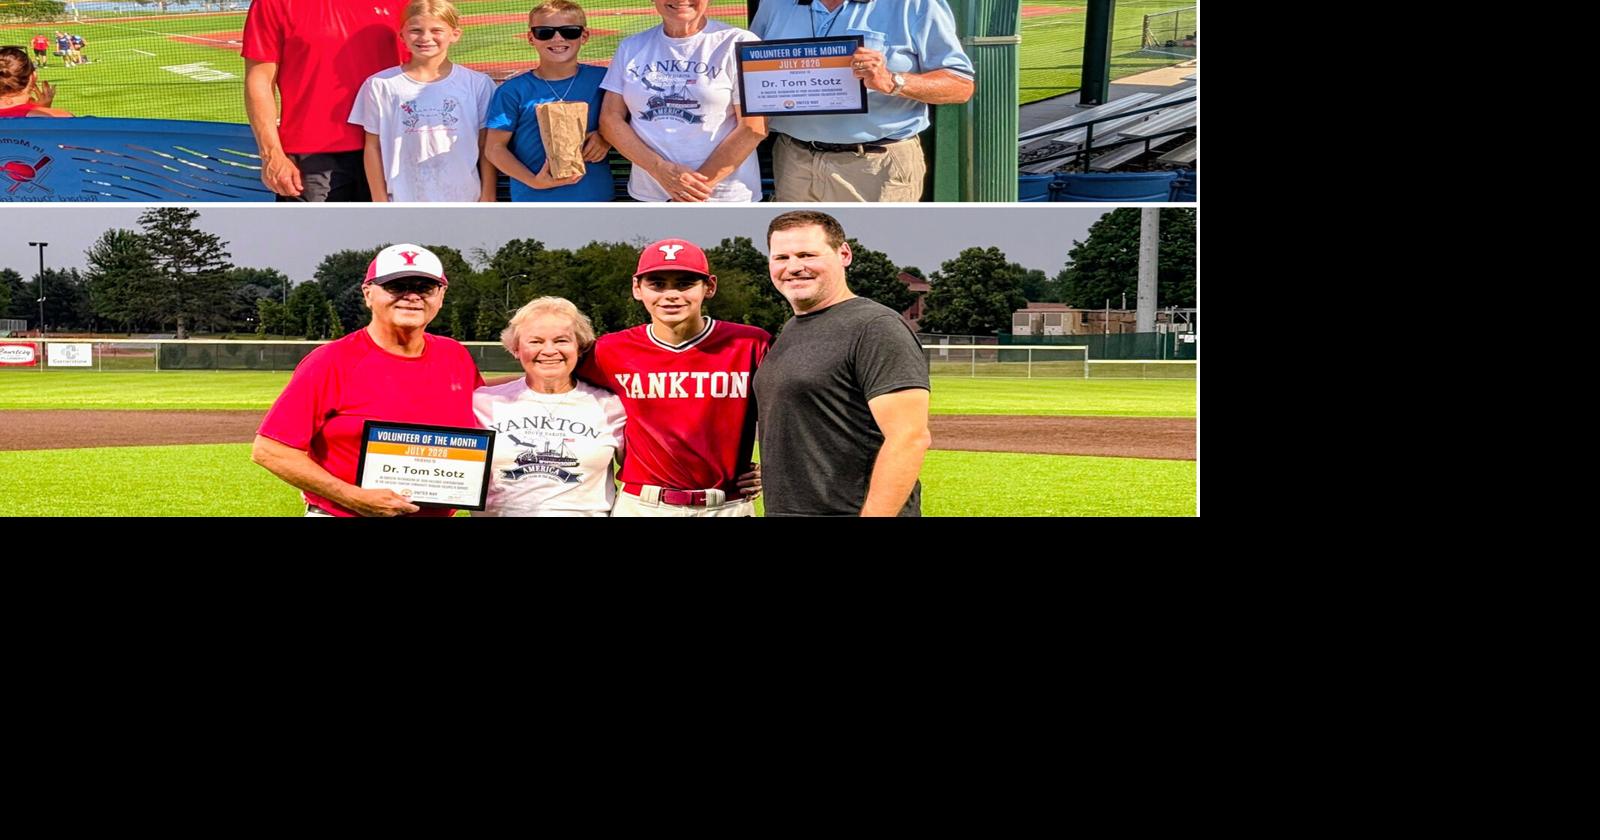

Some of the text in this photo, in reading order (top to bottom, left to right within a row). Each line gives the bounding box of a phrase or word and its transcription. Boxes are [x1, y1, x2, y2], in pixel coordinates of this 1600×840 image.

[749, 45, 847, 59] VOLUNTEER OF THE MONTH
[629, 59, 722, 79] YANKTON
[779, 60, 798, 69] JULY
[761, 77, 841, 88] Dr. Tom Stotz
[652, 107, 684, 117] AMERICA
[398, 250, 420, 266] Y
[658, 244, 684, 260] Y
[615, 371, 750, 399] YANKTON
[489, 415, 601, 439] YANKTON
[377, 431, 478, 448] VOLUNTEER OF THE MONTH
[404, 446, 426, 456] JULY
[382, 464, 465, 479] Dr. Tom Stotz
[522, 464, 560, 476] AMERICA
